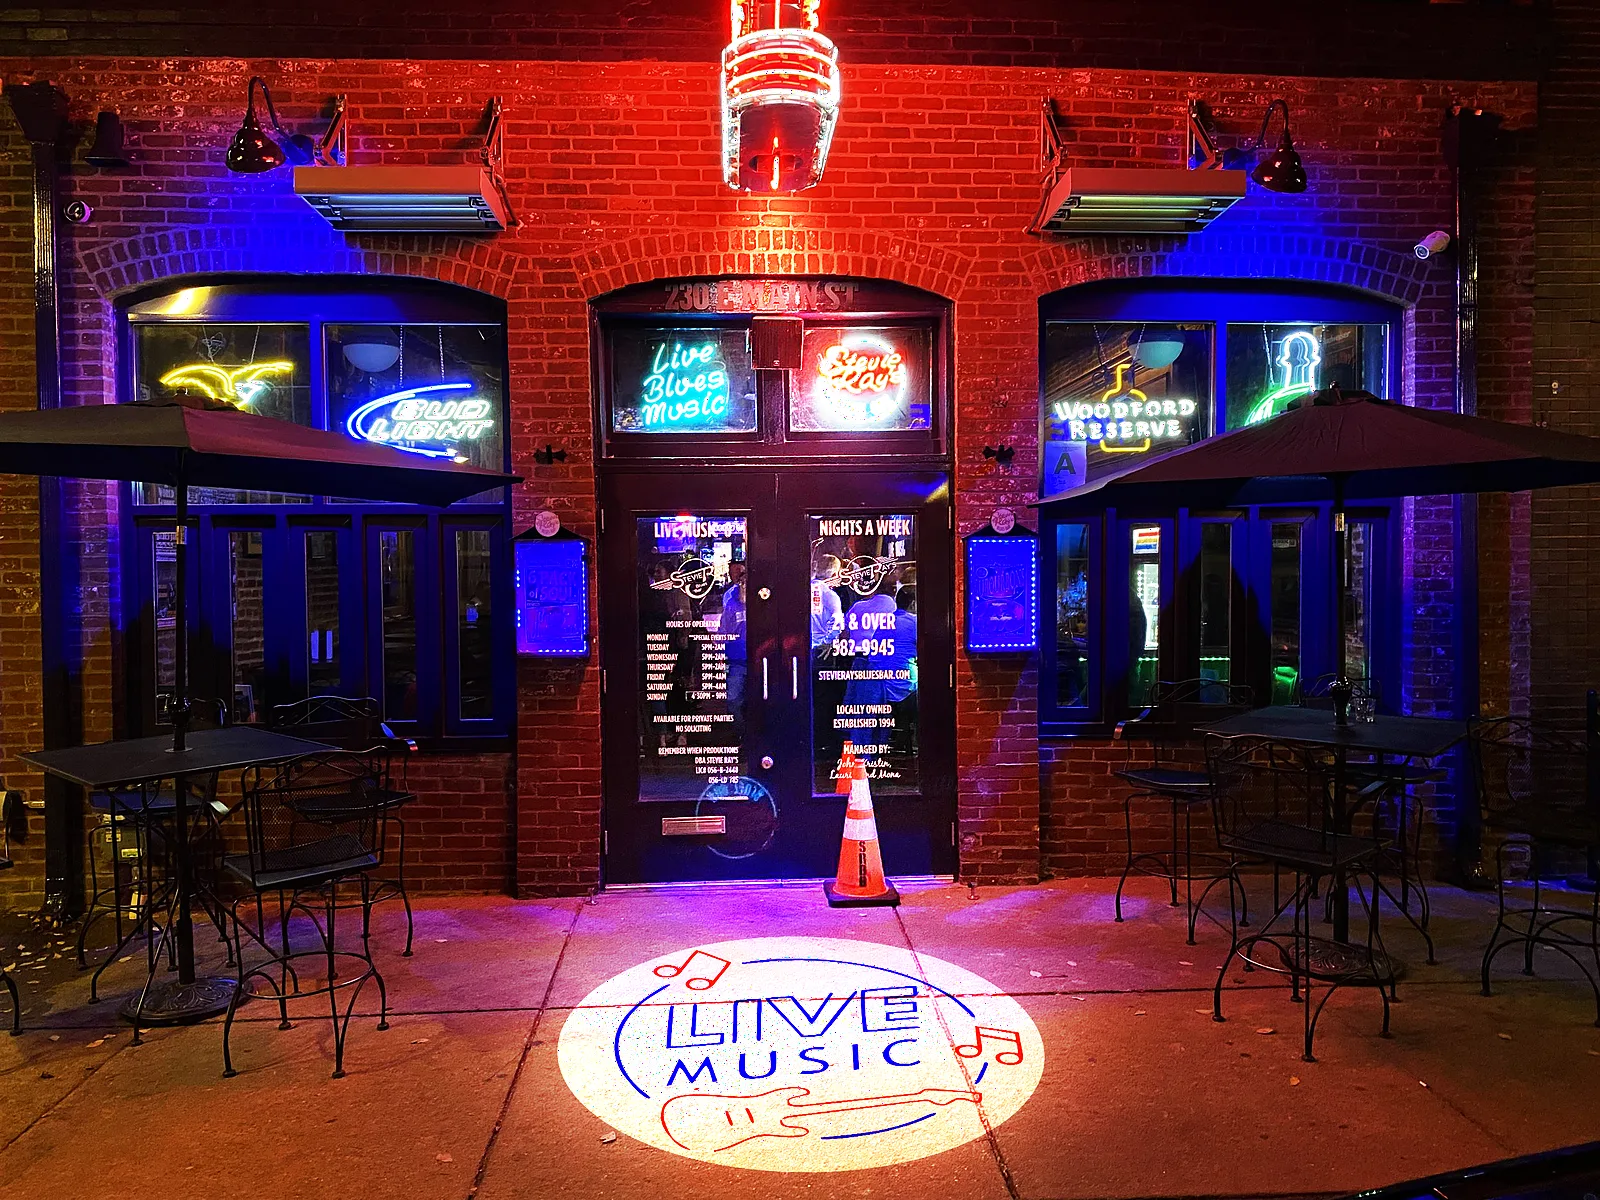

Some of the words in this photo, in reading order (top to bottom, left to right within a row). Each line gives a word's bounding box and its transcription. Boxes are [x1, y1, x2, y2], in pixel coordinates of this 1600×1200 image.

[665, 282, 710, 311] 230
[716, 281, 735, 312] E
[742, 281, 818, 312] MAIN
[824, 282, 860, 311] ST
[652, 343, 716, 375] Live
[818, 345, 902, 377] Stevie
[643, 370, 725, 404] Blues
[391, 398, 491, 421] BUD
[1054, 398, 1197, 421] WOODFORD
[366, 418, 494, 441] LIGHT
[1069, 419, 1183, 441] RESERVE
[1053, 452, 1077, 475] A
[654, 521, 680, 538] LIVE
[819, 519, 863, 536] NIGHTS
[865, 520, 874, 536] A
[876, 519, 911, 536] WEEK
[670, 571, 703, 589] STEVIE
[839, 568, 871, 586] STEVIE
[666, 620, 684, 628] HOURS
[684, 620, 692, 628] OF
[692, 620, 721, 628] OPERATION
[848, 613, 858, 630] &
[861, 612, 896, 630] OVER
[646, 633, 669, 641] MONDAY
[646, 643, 670, 651] TUESDAY
[701, 643, 726, 651] 5PM-2AM
[832, 638, 895, 657] 582-9945
[646, 653, 679, 661] WEDNESDAY
[646, 663, 675, 671] THURSDAY
[818, 670, 911, 680] STEVIERAYSBLUESBAR.COM
[646, 673, 666, 681] FRIDAY
[646, 683, 674, 691] SATURDAY
[646, 693, 668, 701] SUNDAY
[836, 704, 865, 715] LOCALLY
[866, 704, 892, 714] OWNED
[652, 715, 680, 723] AVAILABLE
[713, 714, 734, 722] PARTIES
[833, 718, 878, 728] ESTABLISHED
[878, 718, 896, 728] 1994
[684, 724, 712, 732] SOLICITING
[658, 747, 686, 755] REMEMBER
[703, 746, 739, 754] PRODUCTIONS
[843, 744, 878, 755] MANAGED
[878, 744, 891, 754] BY:
[694, 756, 706, 764] DBA
[706, 756, 724, 764] STEVIE
[665, 985, 922, 1049] LIVE
[665, 1037, 922, 1087] MUSIC
